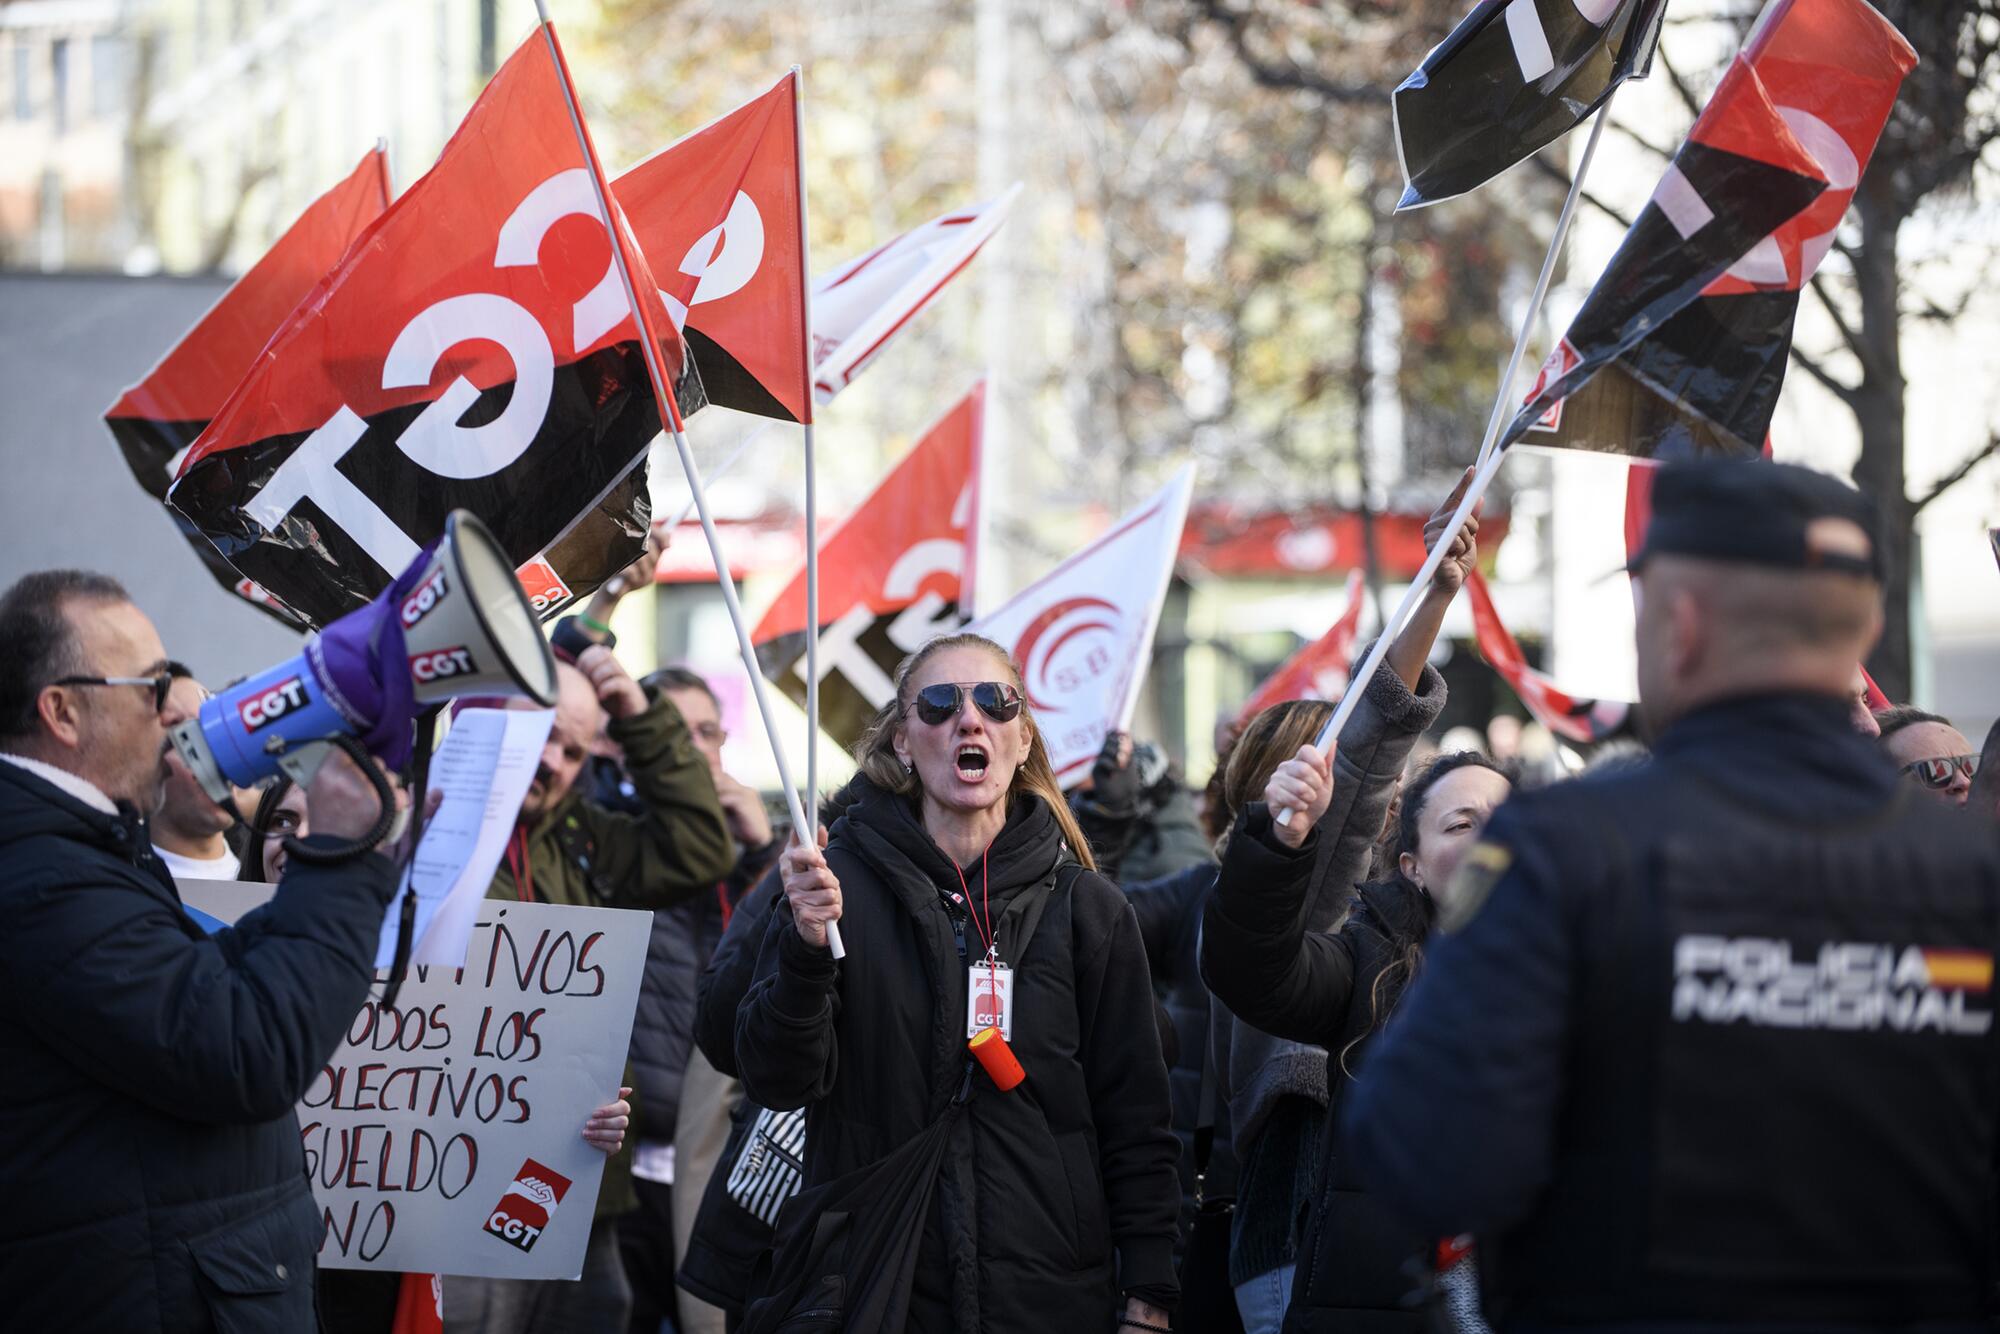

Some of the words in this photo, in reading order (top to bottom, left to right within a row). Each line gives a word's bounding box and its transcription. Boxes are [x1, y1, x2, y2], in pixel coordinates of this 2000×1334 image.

[402, 570, 449, 624] CGT
[412, 650, 471, 679] CGT
[242, 679, 302, 727] CGT
[1674, 934, 1931, 990] POLICIA
[347, 1001, 452, 1053] ODOS
[474, 1006, 546, 1062] LOS
[1671, 975, 1993, 1035] NACIONAL
[489, 1210, 541, 1248] CGT
